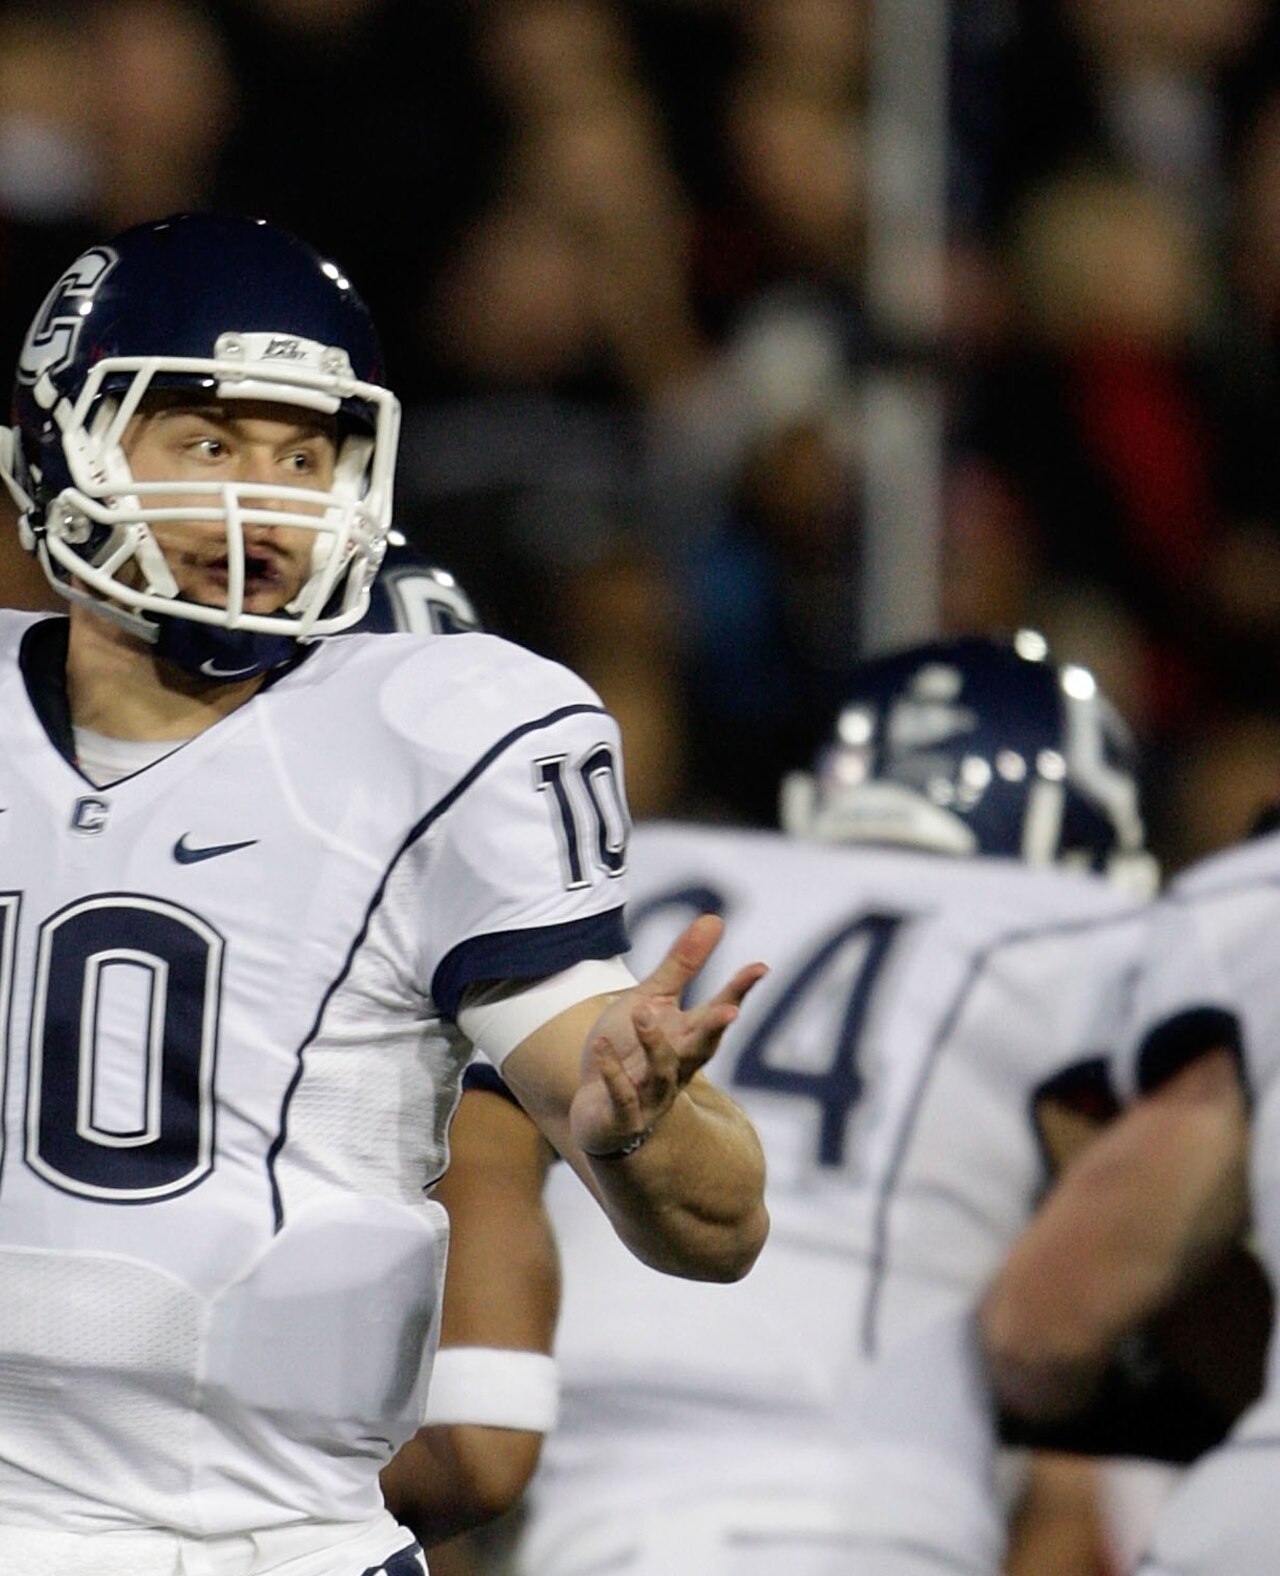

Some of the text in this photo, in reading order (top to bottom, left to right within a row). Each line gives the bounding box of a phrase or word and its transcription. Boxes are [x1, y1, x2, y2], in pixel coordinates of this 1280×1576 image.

[17, 246, 120, 385] C
[69, 795, 109, 836] C
[531, 741, 630, 892] 10
